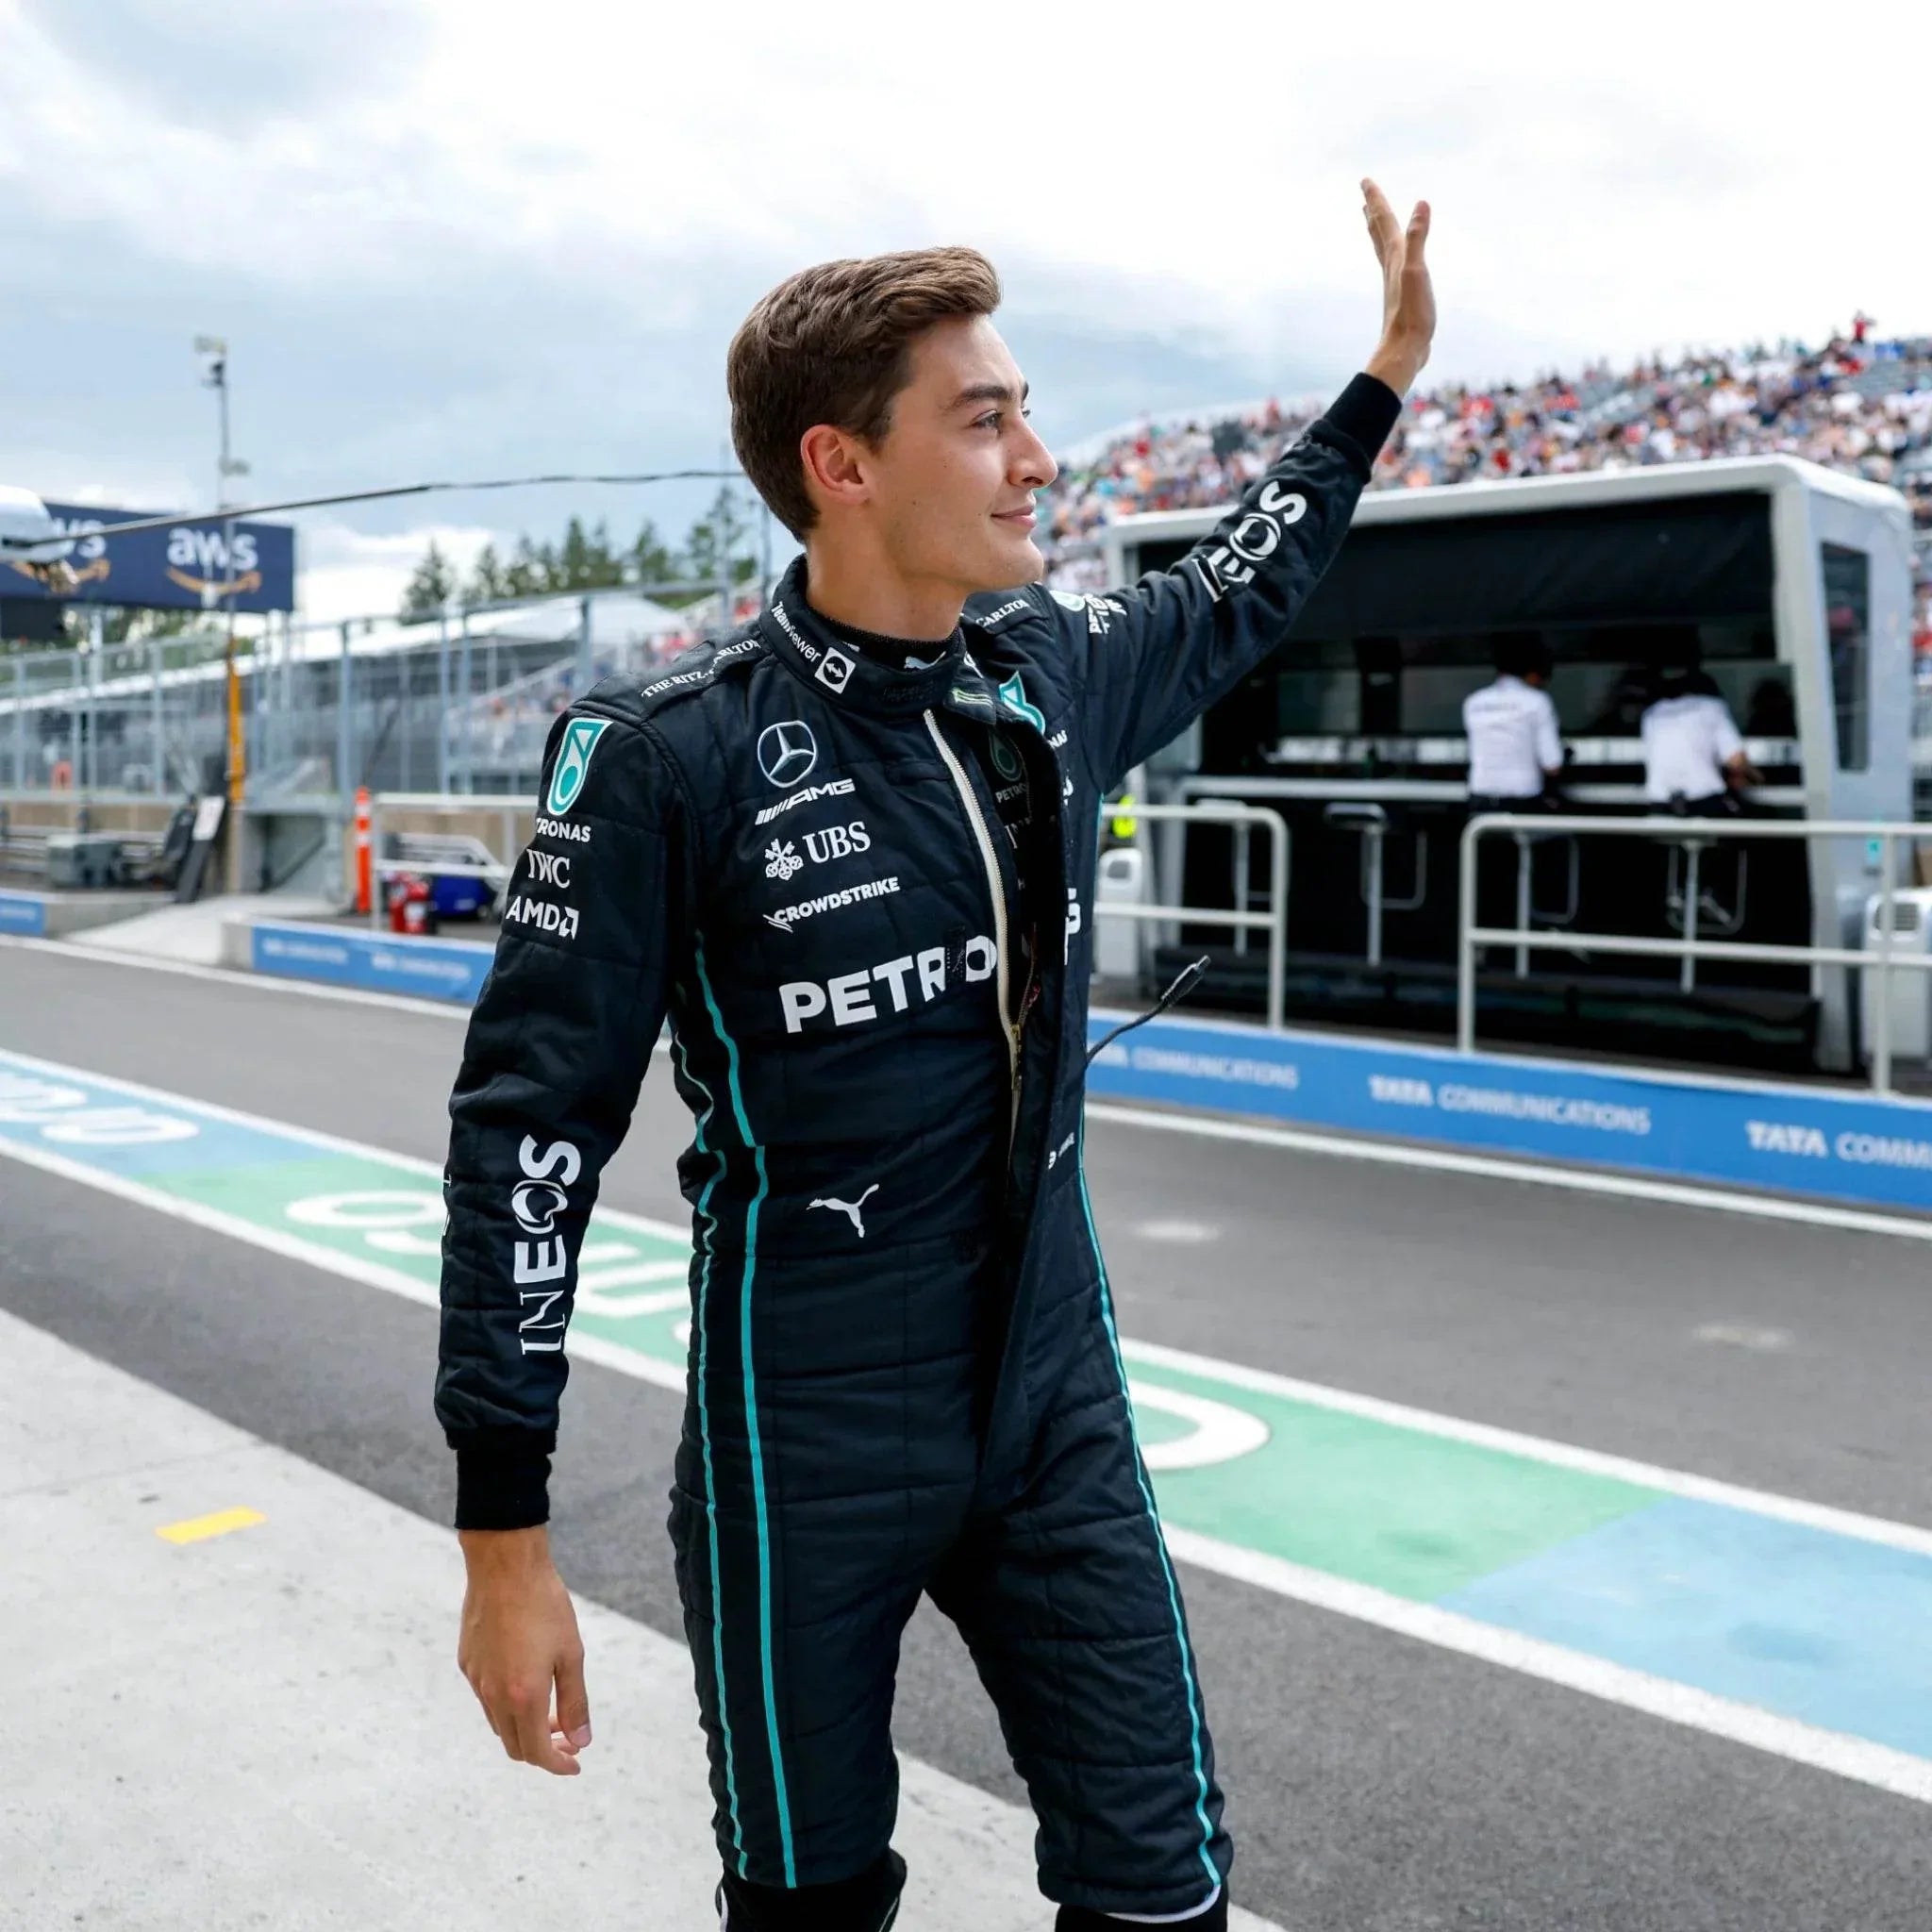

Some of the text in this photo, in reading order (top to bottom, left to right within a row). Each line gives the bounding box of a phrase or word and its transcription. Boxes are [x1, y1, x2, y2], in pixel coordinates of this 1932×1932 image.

[167, 527, 259, 572] aws
[771, 601, 822, 662] Teamiewer
[641, 679, 674, 697] THE
[787, 778, 856, 809] AMG
[802, 821, 871, 863] UBS
[526, 848, 571, 889] IWC
[506, 896, 560, 931] AMD
[774, 876, 901, 924] CROWDSTRIKE
[1369, 1074, 1651, 1135] TATA COMMUNICATIONS
[1745, 1120, 1828, 1158] TATA
[511, 1134, 581, 1355] INEOS
